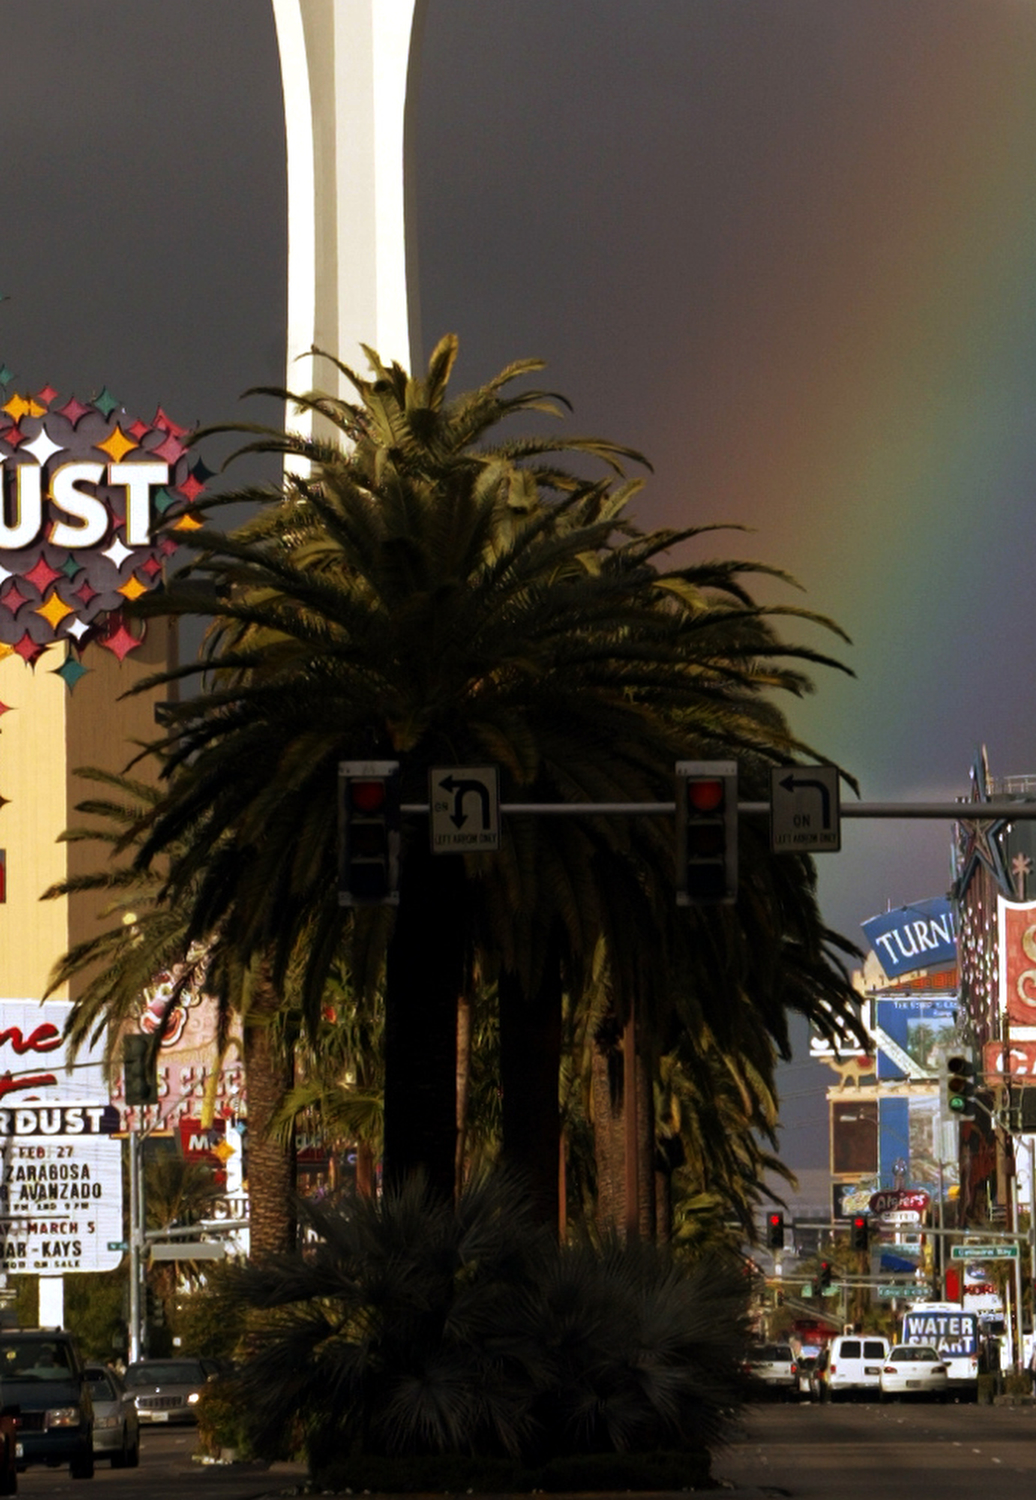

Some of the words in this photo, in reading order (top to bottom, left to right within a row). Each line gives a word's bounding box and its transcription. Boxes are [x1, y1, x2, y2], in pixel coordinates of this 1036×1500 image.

[0, 461, 169, 550] UST
[793, 814, 811, 827] ON
[875, 912, 956, 965] TURN
[19, 1146, 46, 1159] FEB
[57, 1145, 74, 1158] 27
[20, 1182, 103, 1201] AVANZADO
[27, 1221, 79, 1235] MARCH
[87, 1220, 96, 1234] 5
[54, 1259, 81, 1268] SALE
[908, 1318, 973, 1334] WATER
[908, 1336, 973, 1353] SMART
